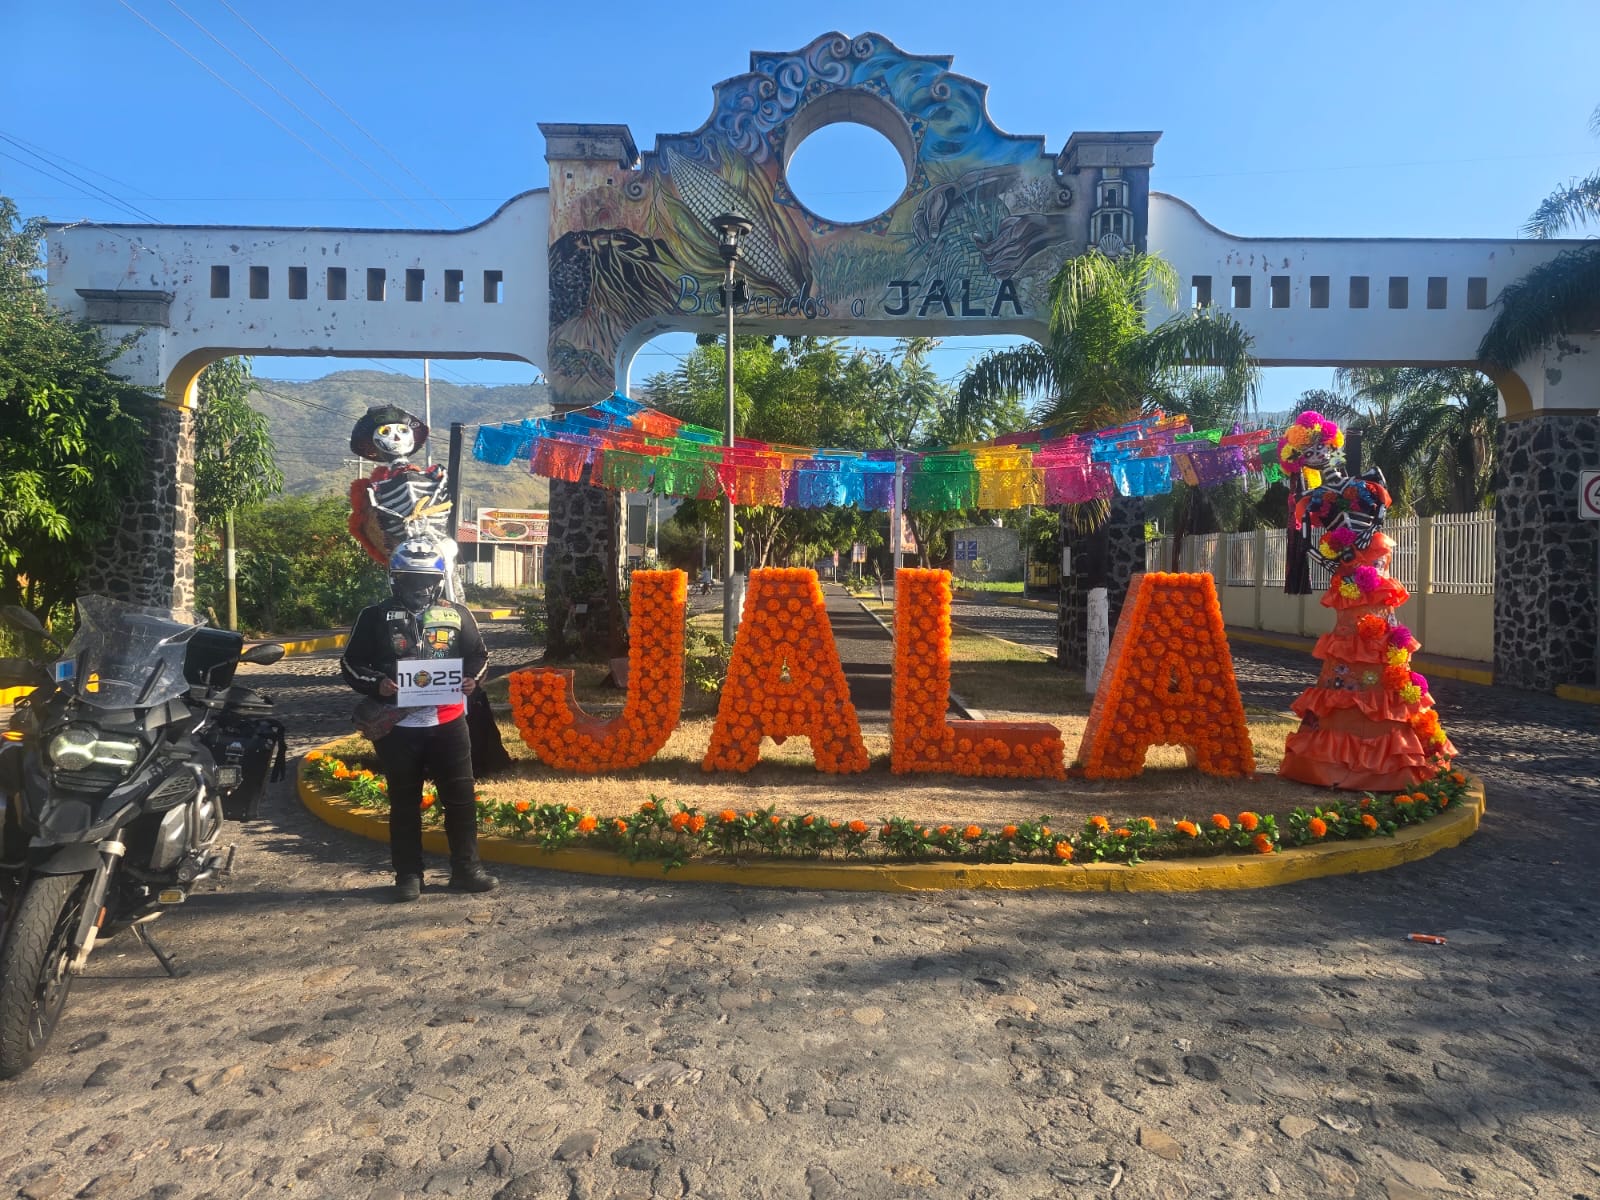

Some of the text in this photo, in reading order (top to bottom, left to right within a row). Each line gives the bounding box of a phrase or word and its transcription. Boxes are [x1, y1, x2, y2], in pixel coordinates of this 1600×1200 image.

[675, 273, 1024, 320] Bievenidos a JALA
[509, 566, 1256, 780] JALA
